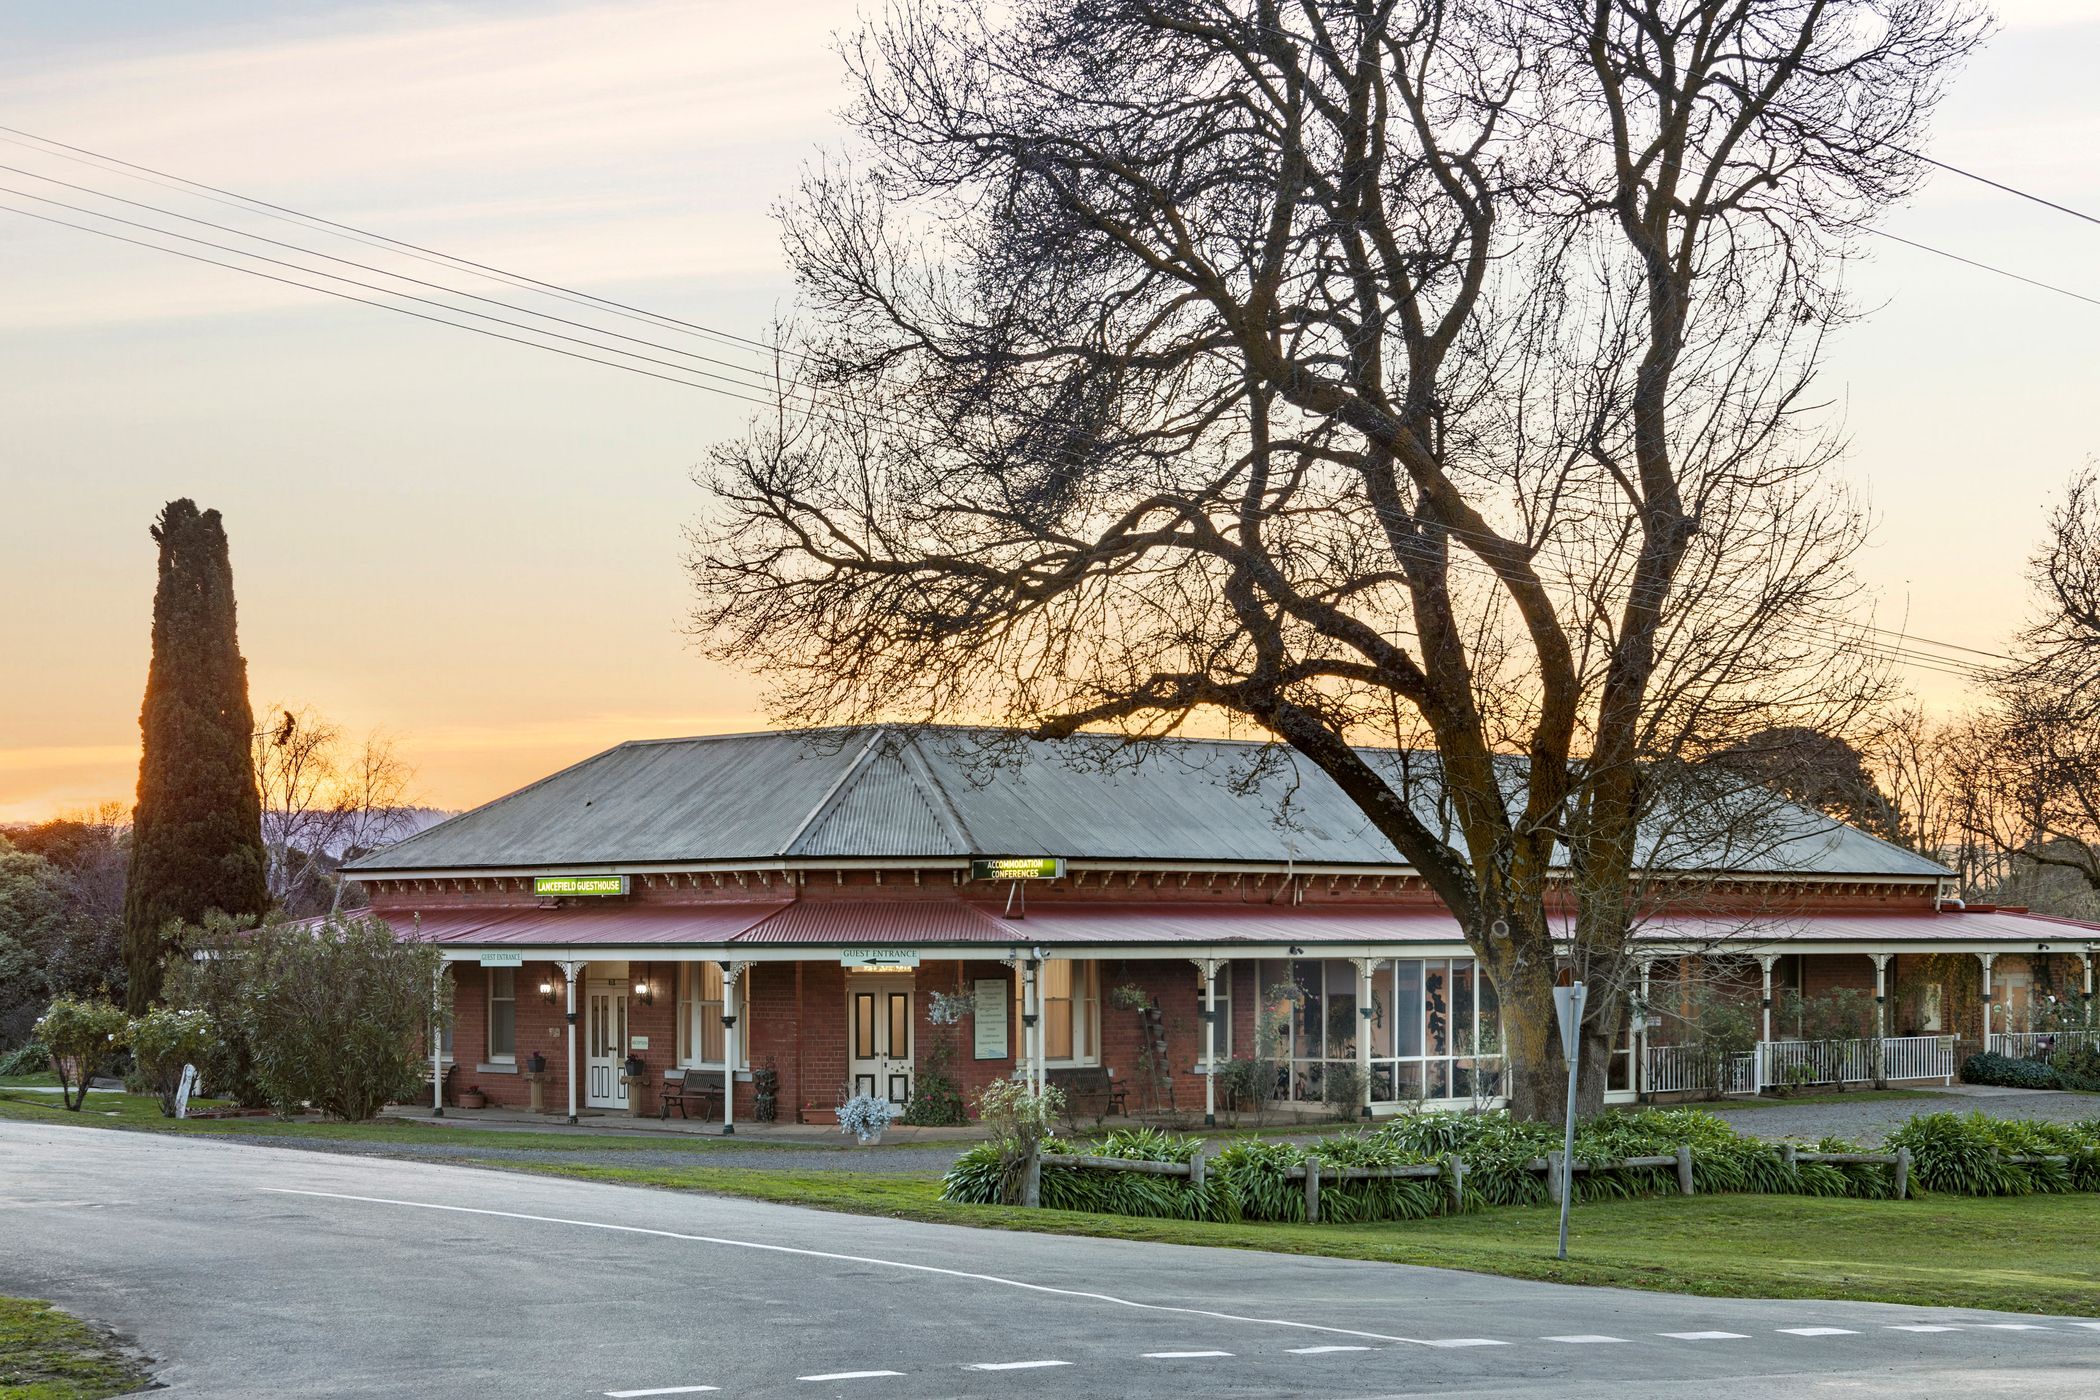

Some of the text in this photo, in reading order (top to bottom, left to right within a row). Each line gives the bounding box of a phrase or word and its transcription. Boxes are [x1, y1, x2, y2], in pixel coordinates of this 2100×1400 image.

[987, 858, 1044, 869] ACCOMMODATION
[991, 869, 1039, 879] CONFERENCES
[537, 880, 620, 892] LANCEFIELD GUESTHOUSE
[481, 953, 521, 961] GUEST ENTRANCE
[843, 949, 918, 958] GUEST ENTRANCE
